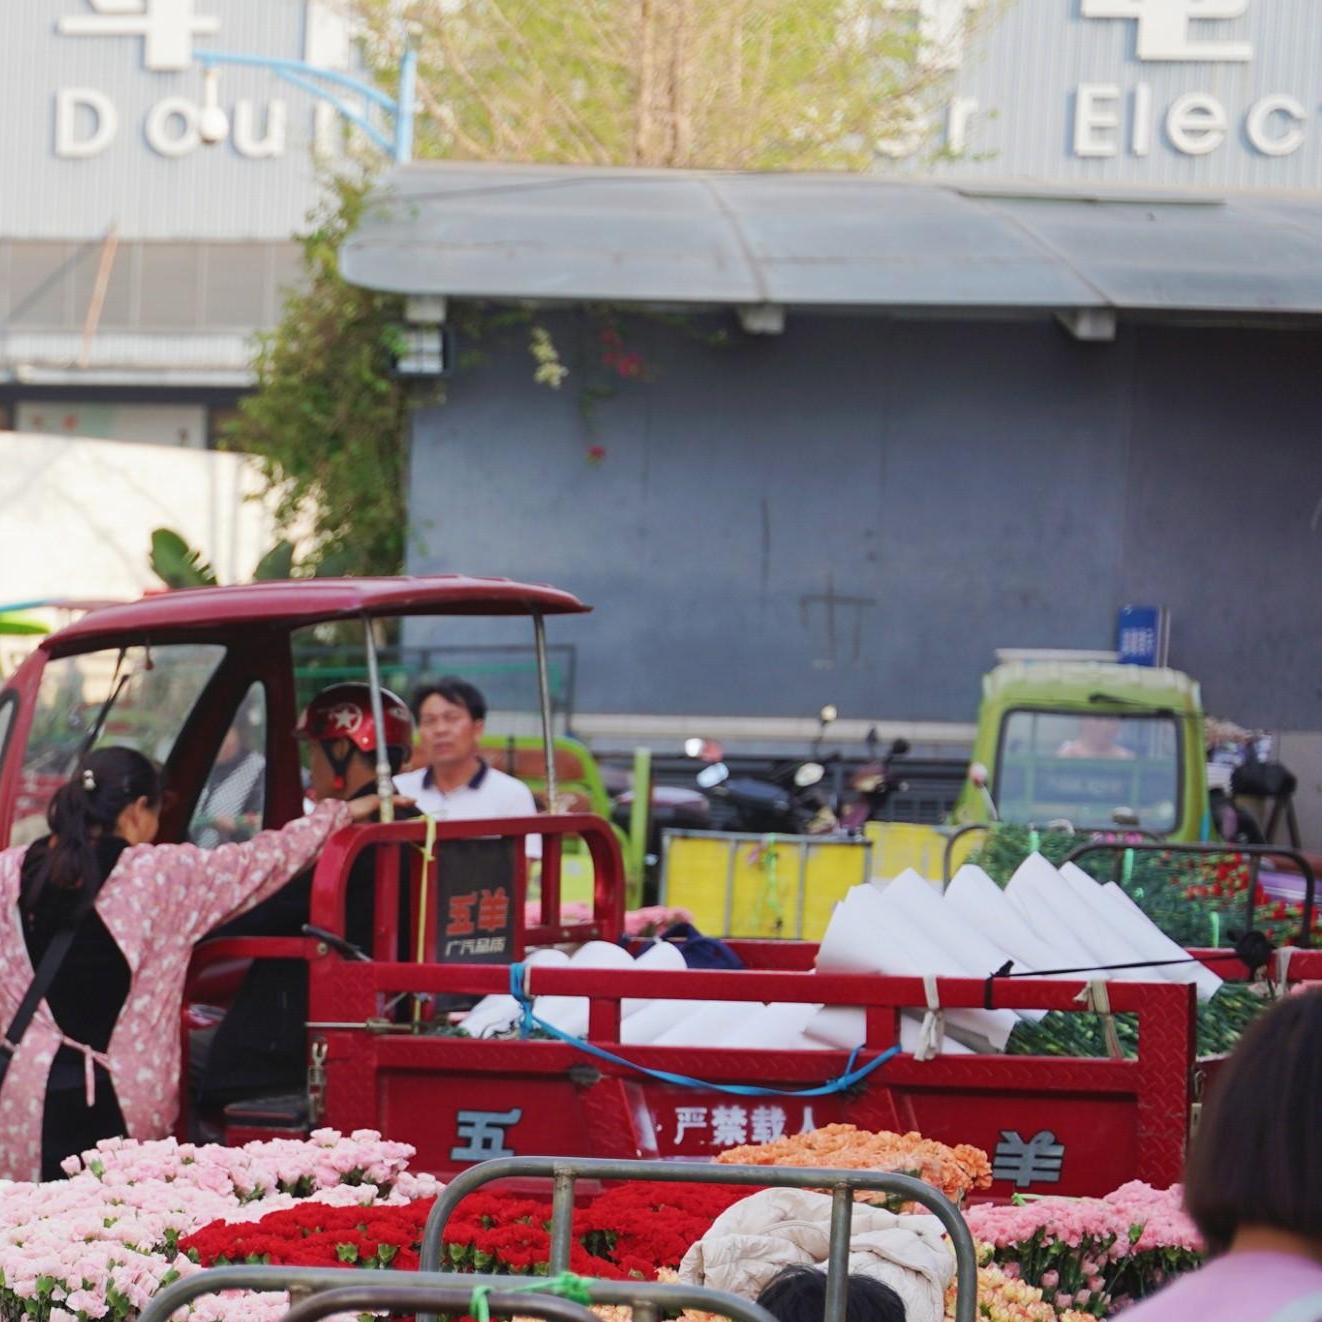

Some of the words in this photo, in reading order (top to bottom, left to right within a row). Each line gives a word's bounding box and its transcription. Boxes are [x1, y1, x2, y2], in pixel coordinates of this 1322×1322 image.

[445, 886, 509, 936] 五羊
[450, 1108, 522, 1161] 五
[673, 1104, 817, 1147] 严禁载人
[993, 1130, 1065, 1187] 羊
